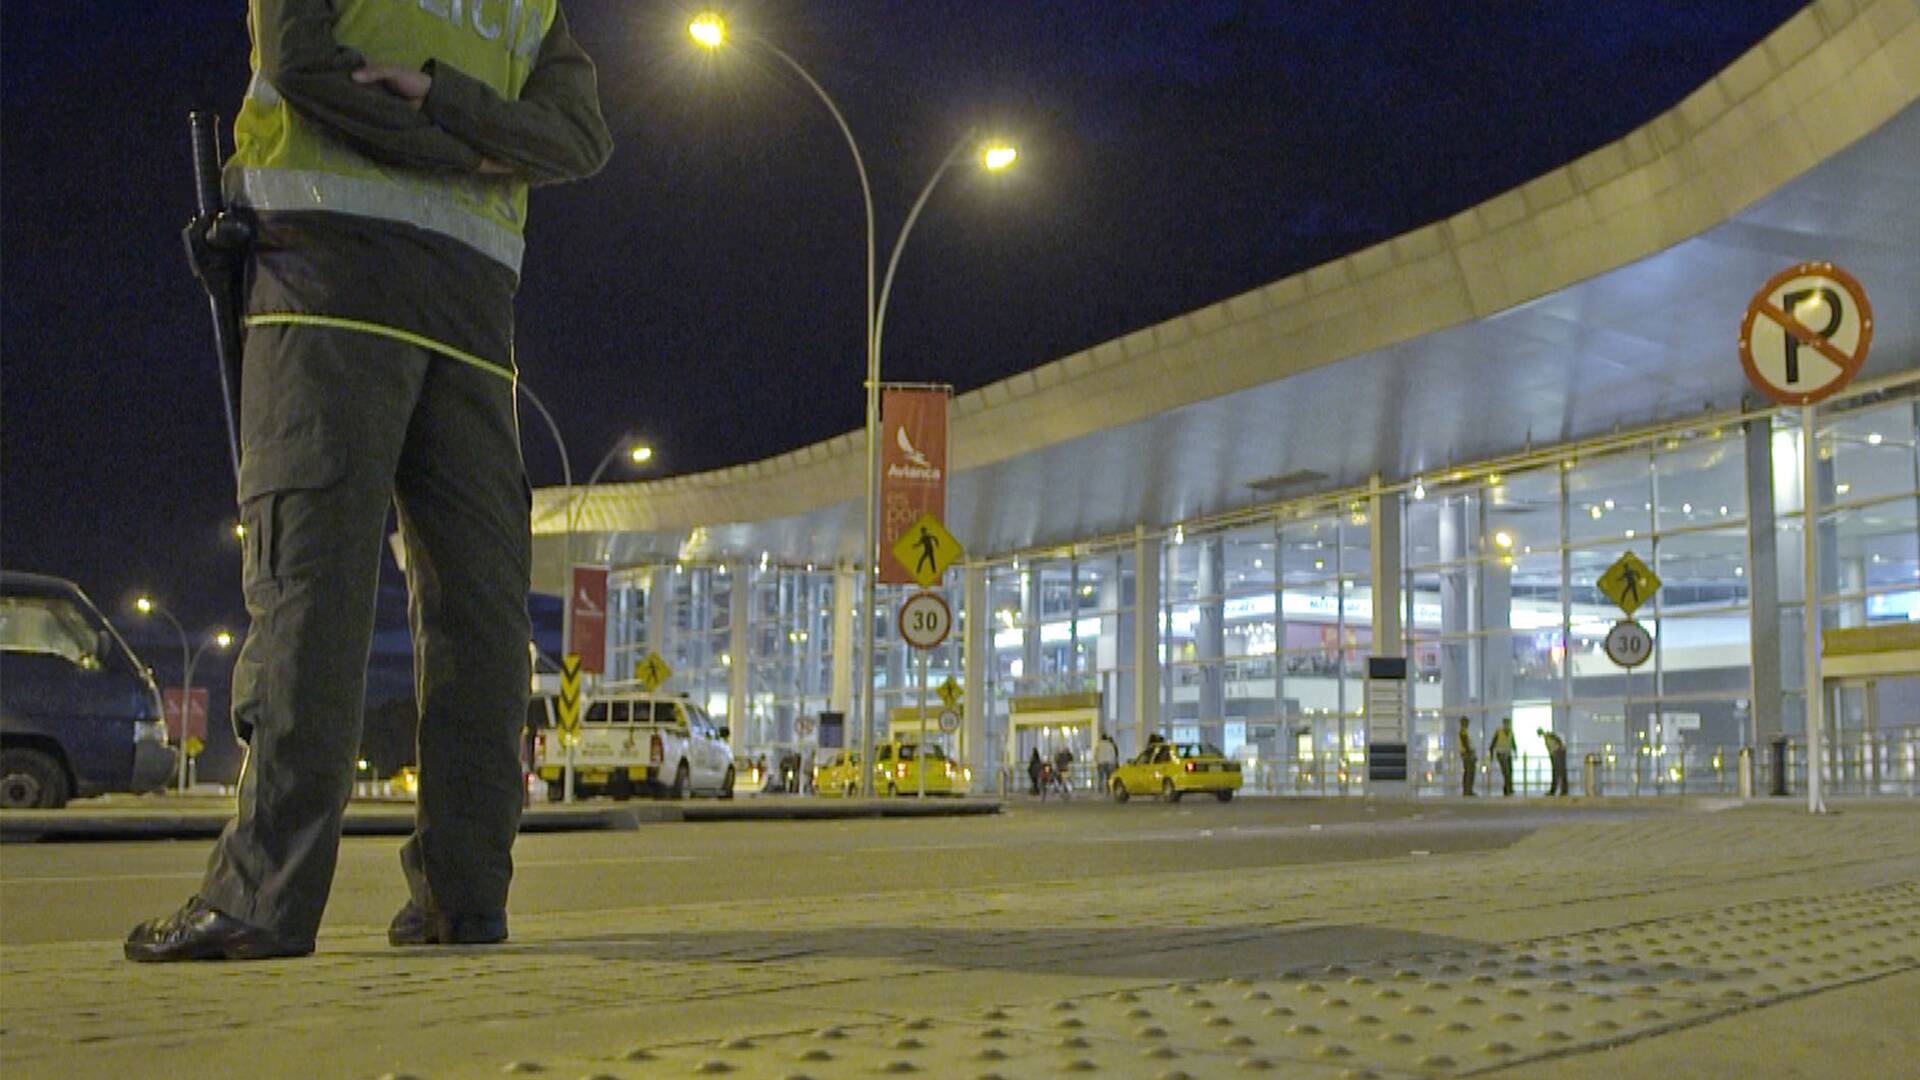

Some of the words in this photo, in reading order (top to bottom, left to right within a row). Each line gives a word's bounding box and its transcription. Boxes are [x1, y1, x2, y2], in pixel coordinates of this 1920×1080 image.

[1783, 286, 1842, 382] P
[888, 463, 941, 479] Avianca
[912, 610, 938, 632] 30
[1617, 635, 1641, 654] 30
